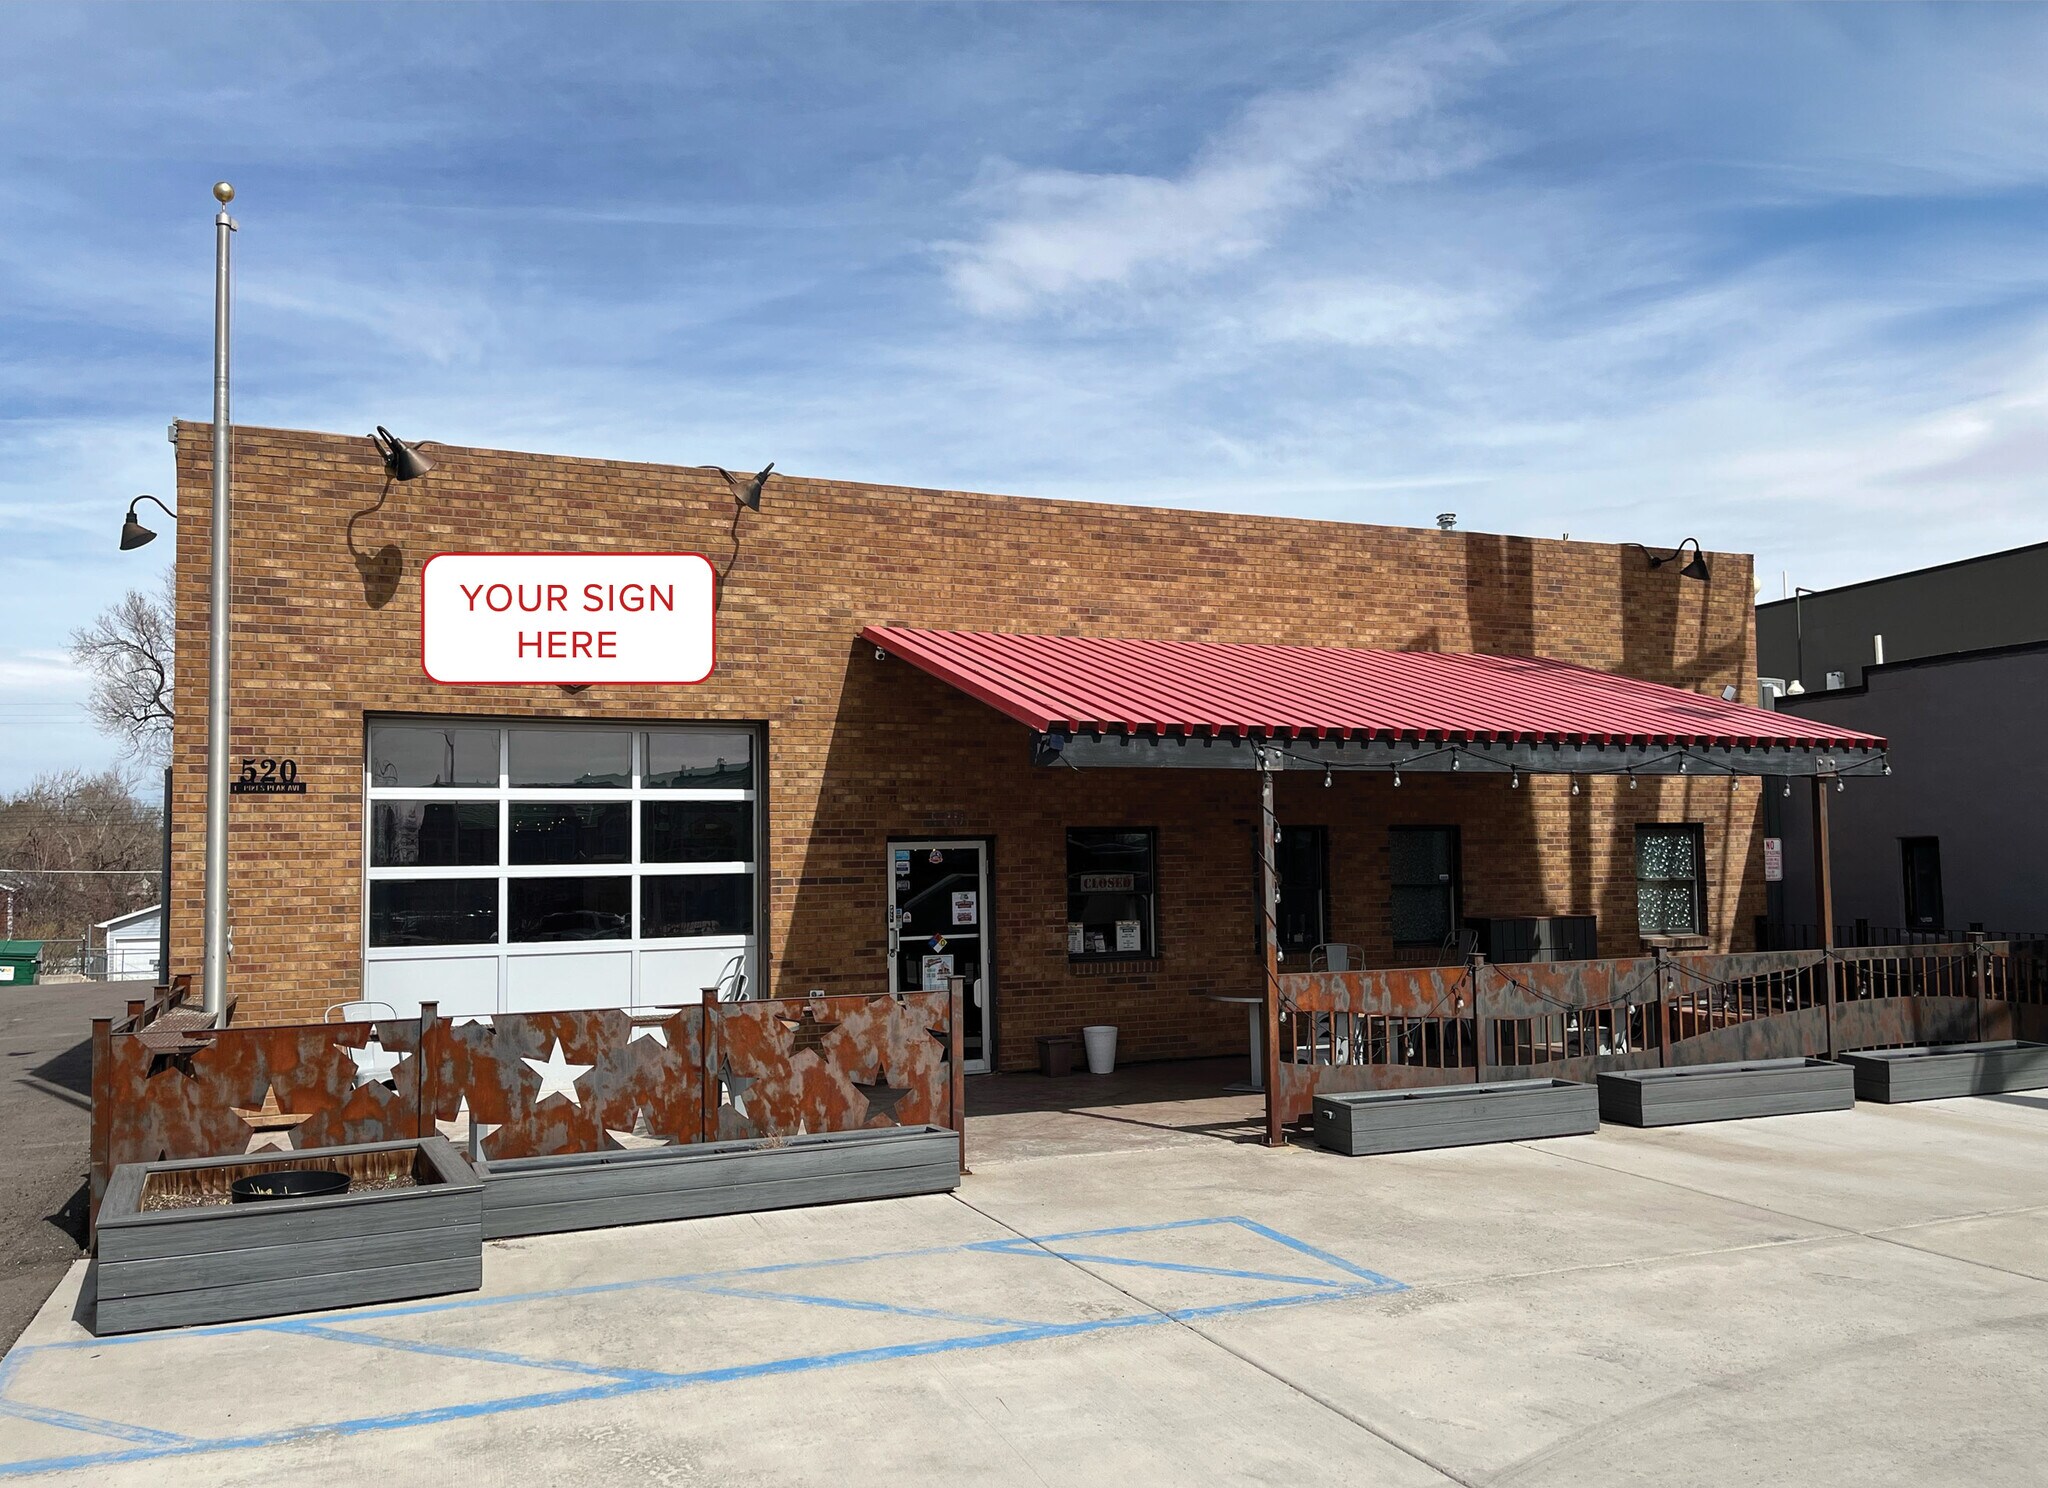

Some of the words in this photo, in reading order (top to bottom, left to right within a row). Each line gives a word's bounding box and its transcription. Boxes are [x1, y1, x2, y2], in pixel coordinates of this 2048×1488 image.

[240, 758, 297, 782] 520
[1765, 840, 1775, 850] NO
[1083, 877, 1132, 889] CLOSED
